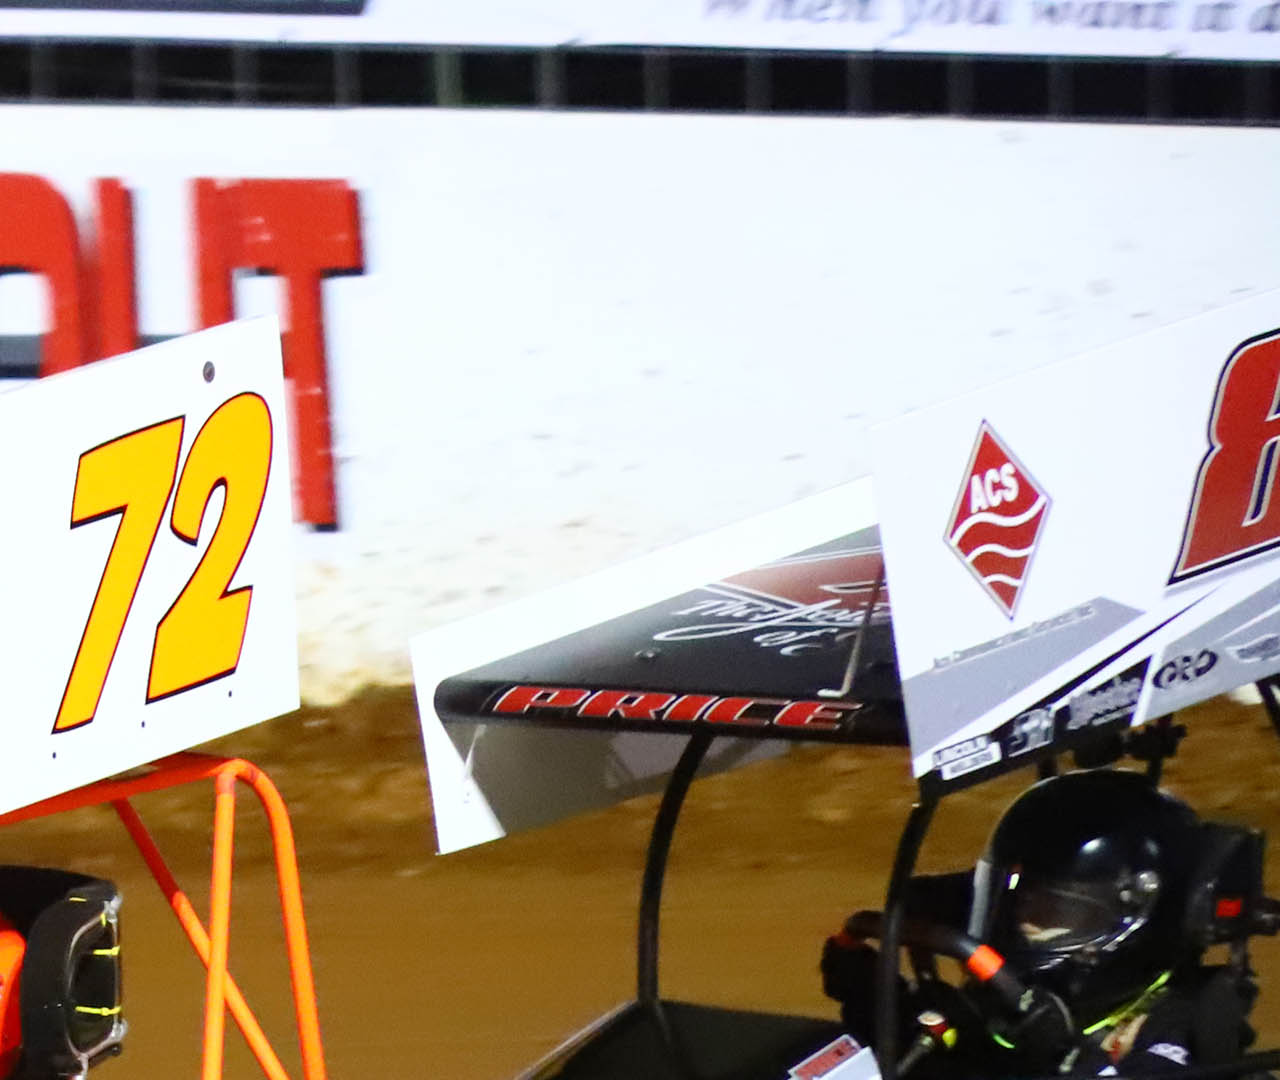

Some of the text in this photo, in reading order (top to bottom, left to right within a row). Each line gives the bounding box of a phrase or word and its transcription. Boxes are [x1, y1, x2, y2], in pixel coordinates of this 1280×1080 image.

[970, 462, 1019, 513] ACS
[51, 390, 274, 735] 72
[493, 685, 863, 731] PRICE
